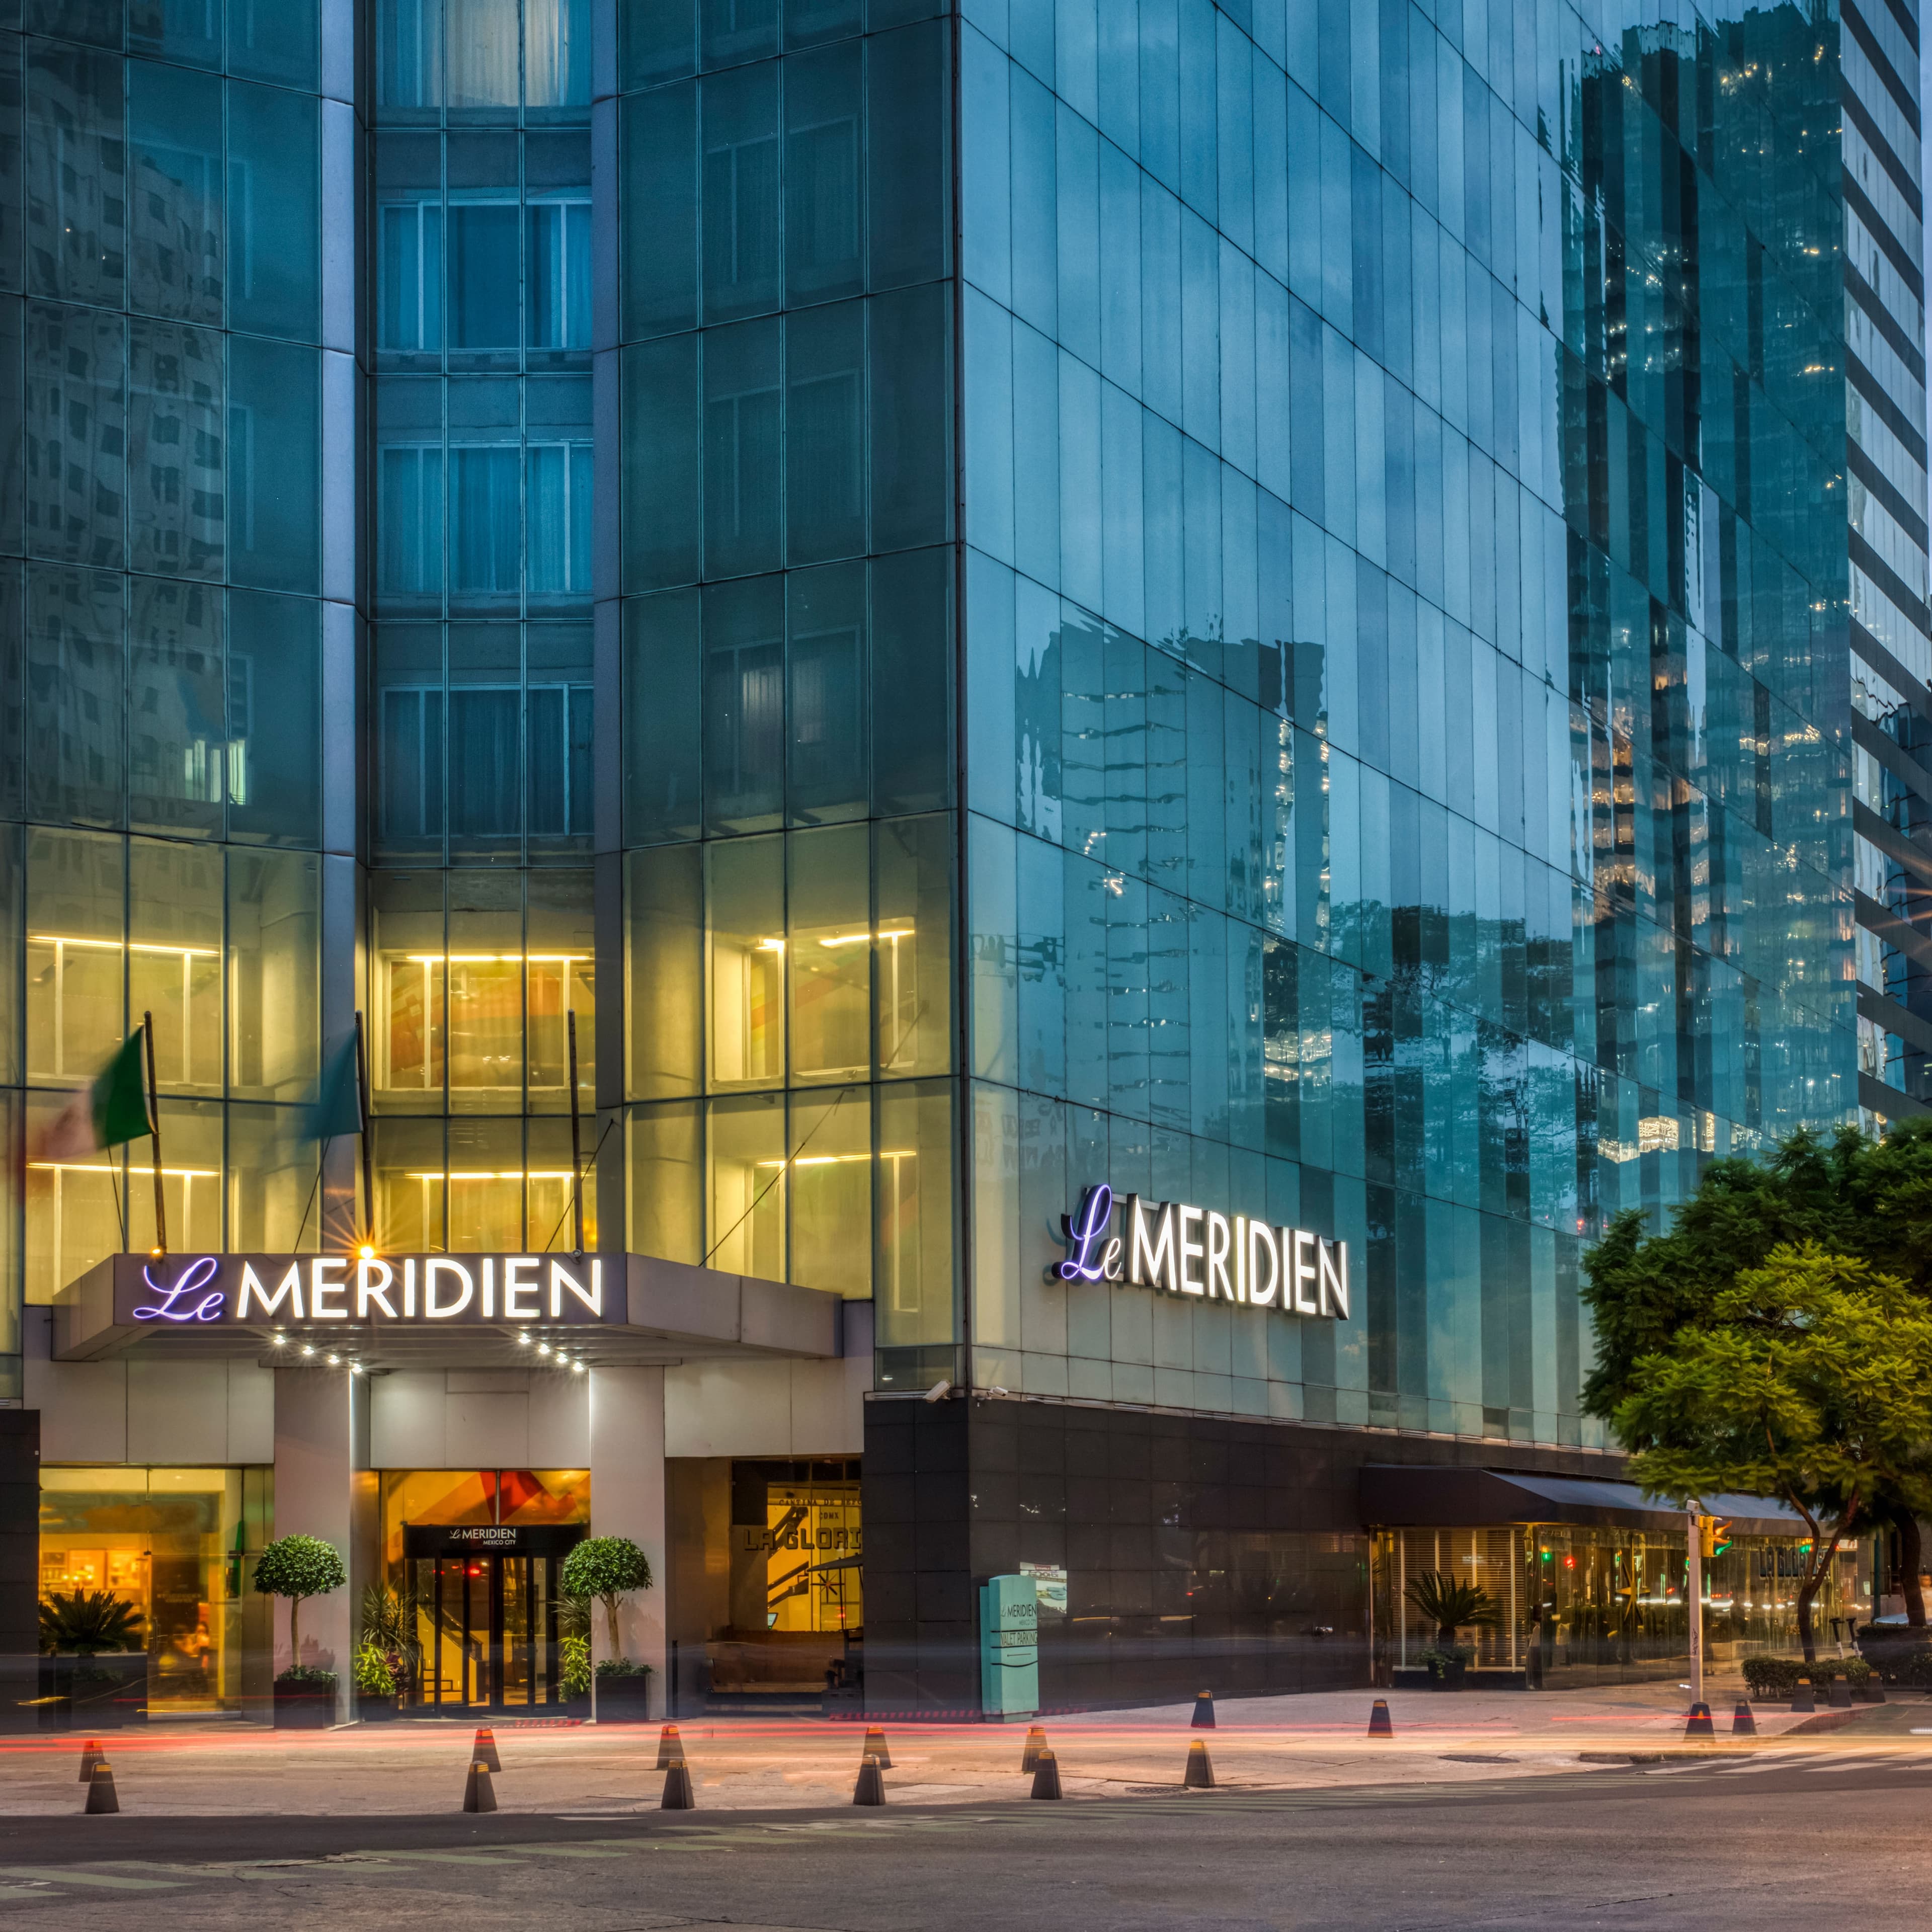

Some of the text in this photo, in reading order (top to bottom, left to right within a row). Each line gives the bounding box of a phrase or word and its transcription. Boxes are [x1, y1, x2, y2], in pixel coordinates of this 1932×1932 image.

[1059, 1183, 1349, 1321] Le MERIDIEN
[132, 1256, 602, 1322] Le MERIDIEN
[449, 1528, 516, 1539] Le MERIDIEN
[744, 1528, 776, 1551] LA
[1007, 1603, 1037, 1617] MERIDIEN
[1000, 1631, 1037, 1646] VALET PARKING
